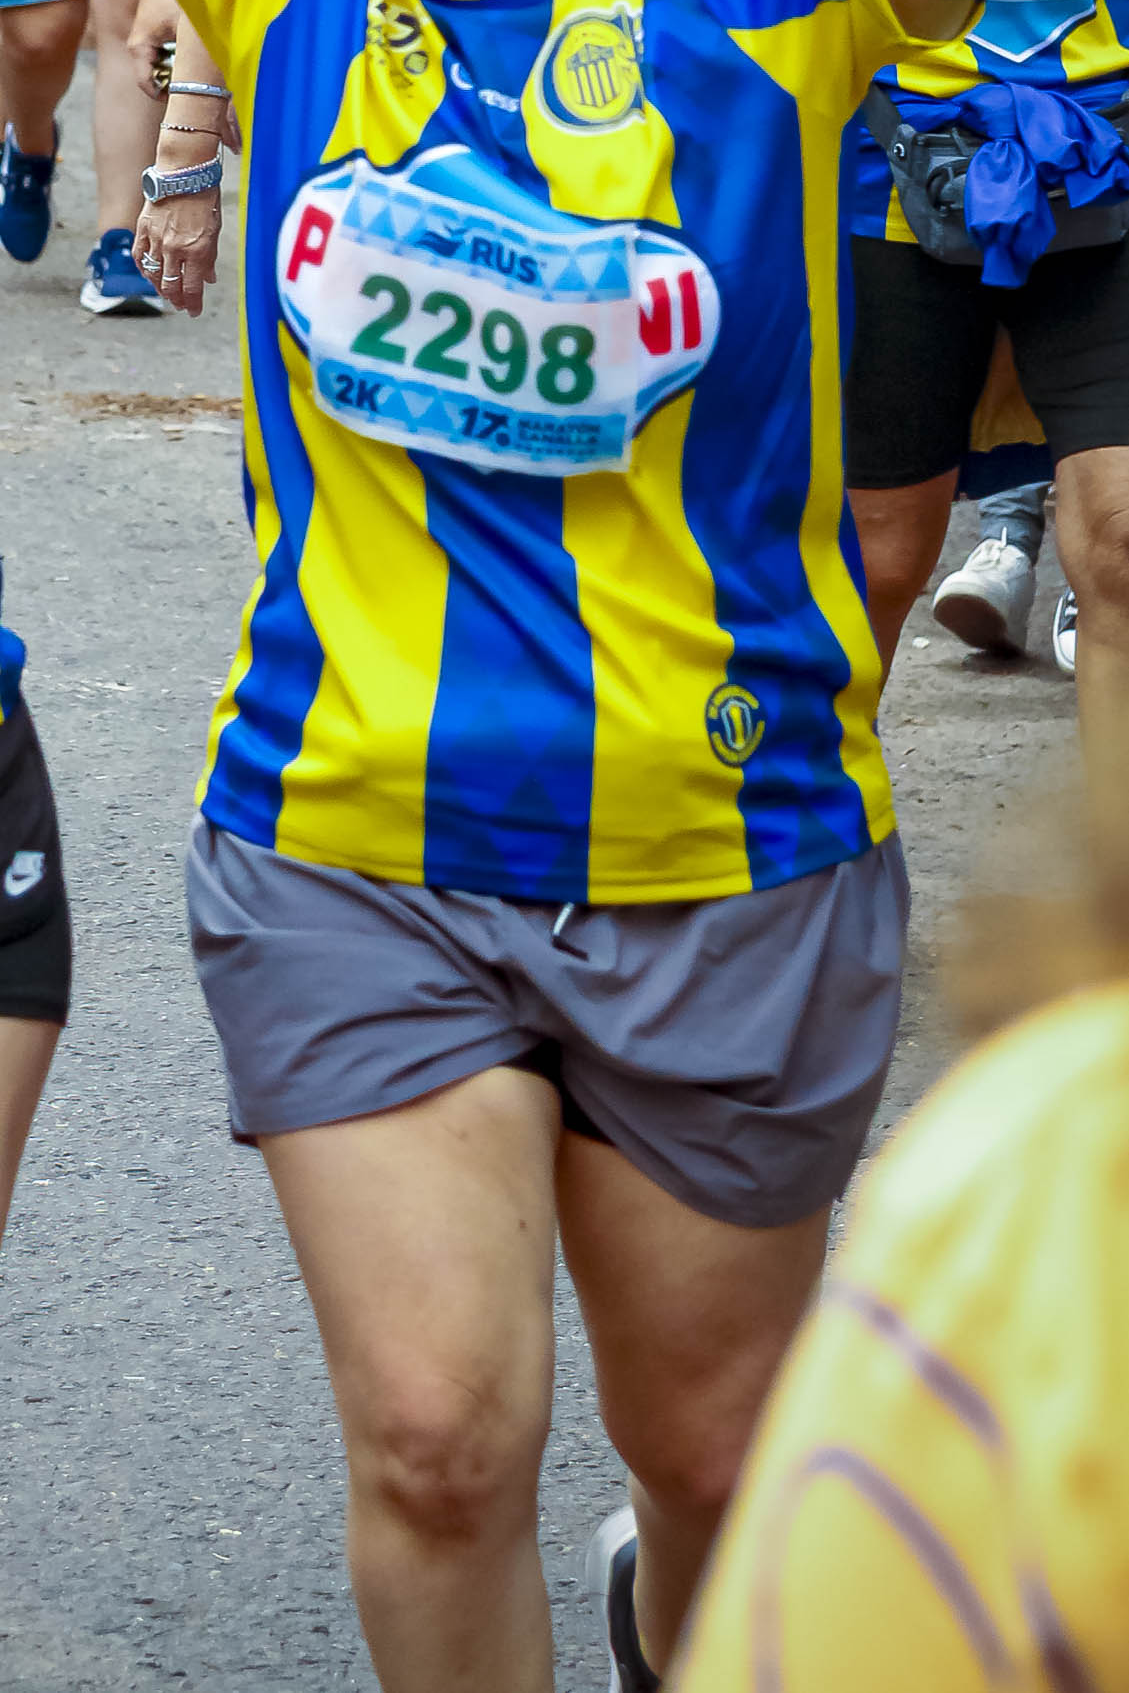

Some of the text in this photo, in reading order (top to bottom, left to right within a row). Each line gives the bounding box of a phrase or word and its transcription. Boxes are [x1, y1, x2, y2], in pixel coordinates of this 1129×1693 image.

[471, 235, 541, 285] RUS
[349, 273, 596, 407] 2298
[333, 372, 384, 415] 2K
